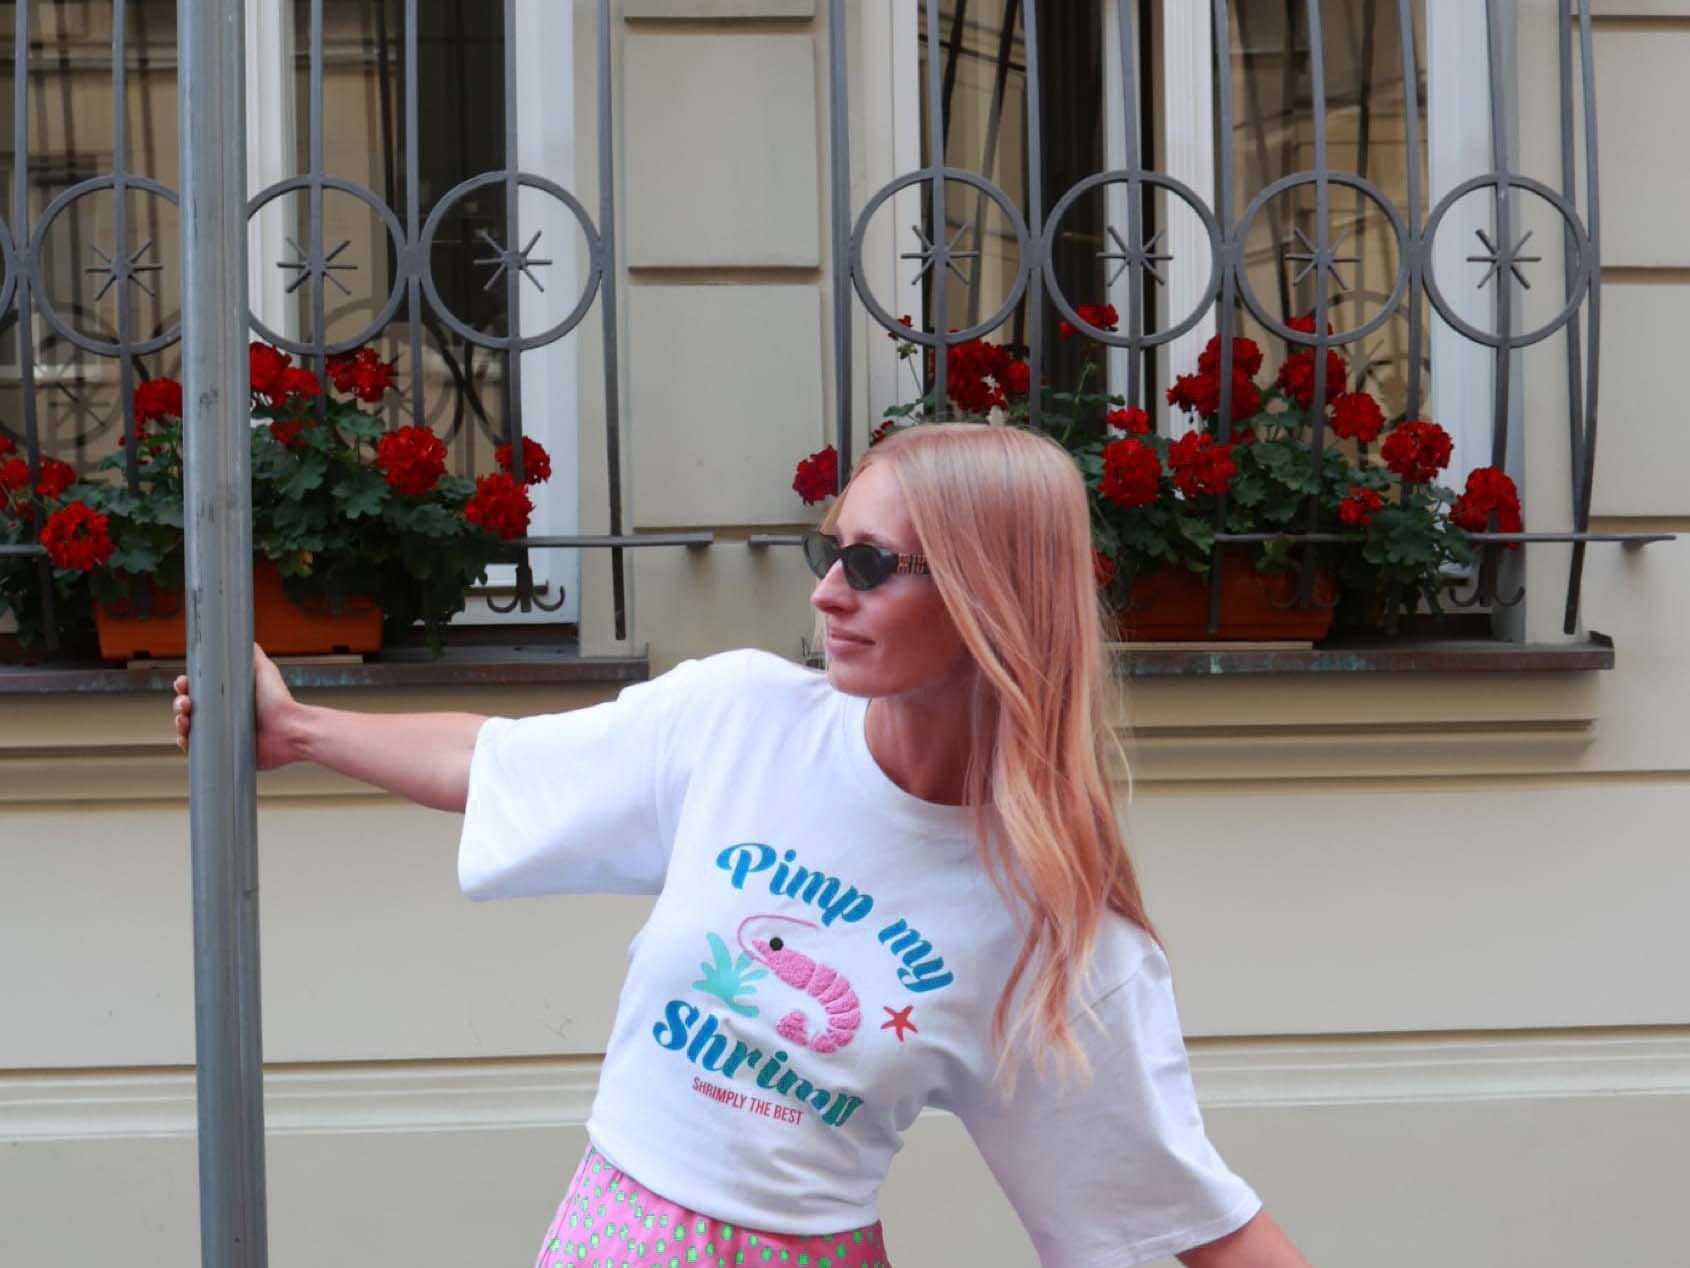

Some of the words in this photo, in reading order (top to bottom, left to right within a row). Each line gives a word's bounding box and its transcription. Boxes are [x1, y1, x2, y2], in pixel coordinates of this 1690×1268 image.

[716, 842, 874, 926] Pimp
[878, 918, 954, 993] my
[652, 1000, 863, 1127] Shrimp
[692, 1077, 747, 1109] SHRIMPLY
[749, 1097, 771, 1116] THE
[773, 1105, 803, 1125] BEST
